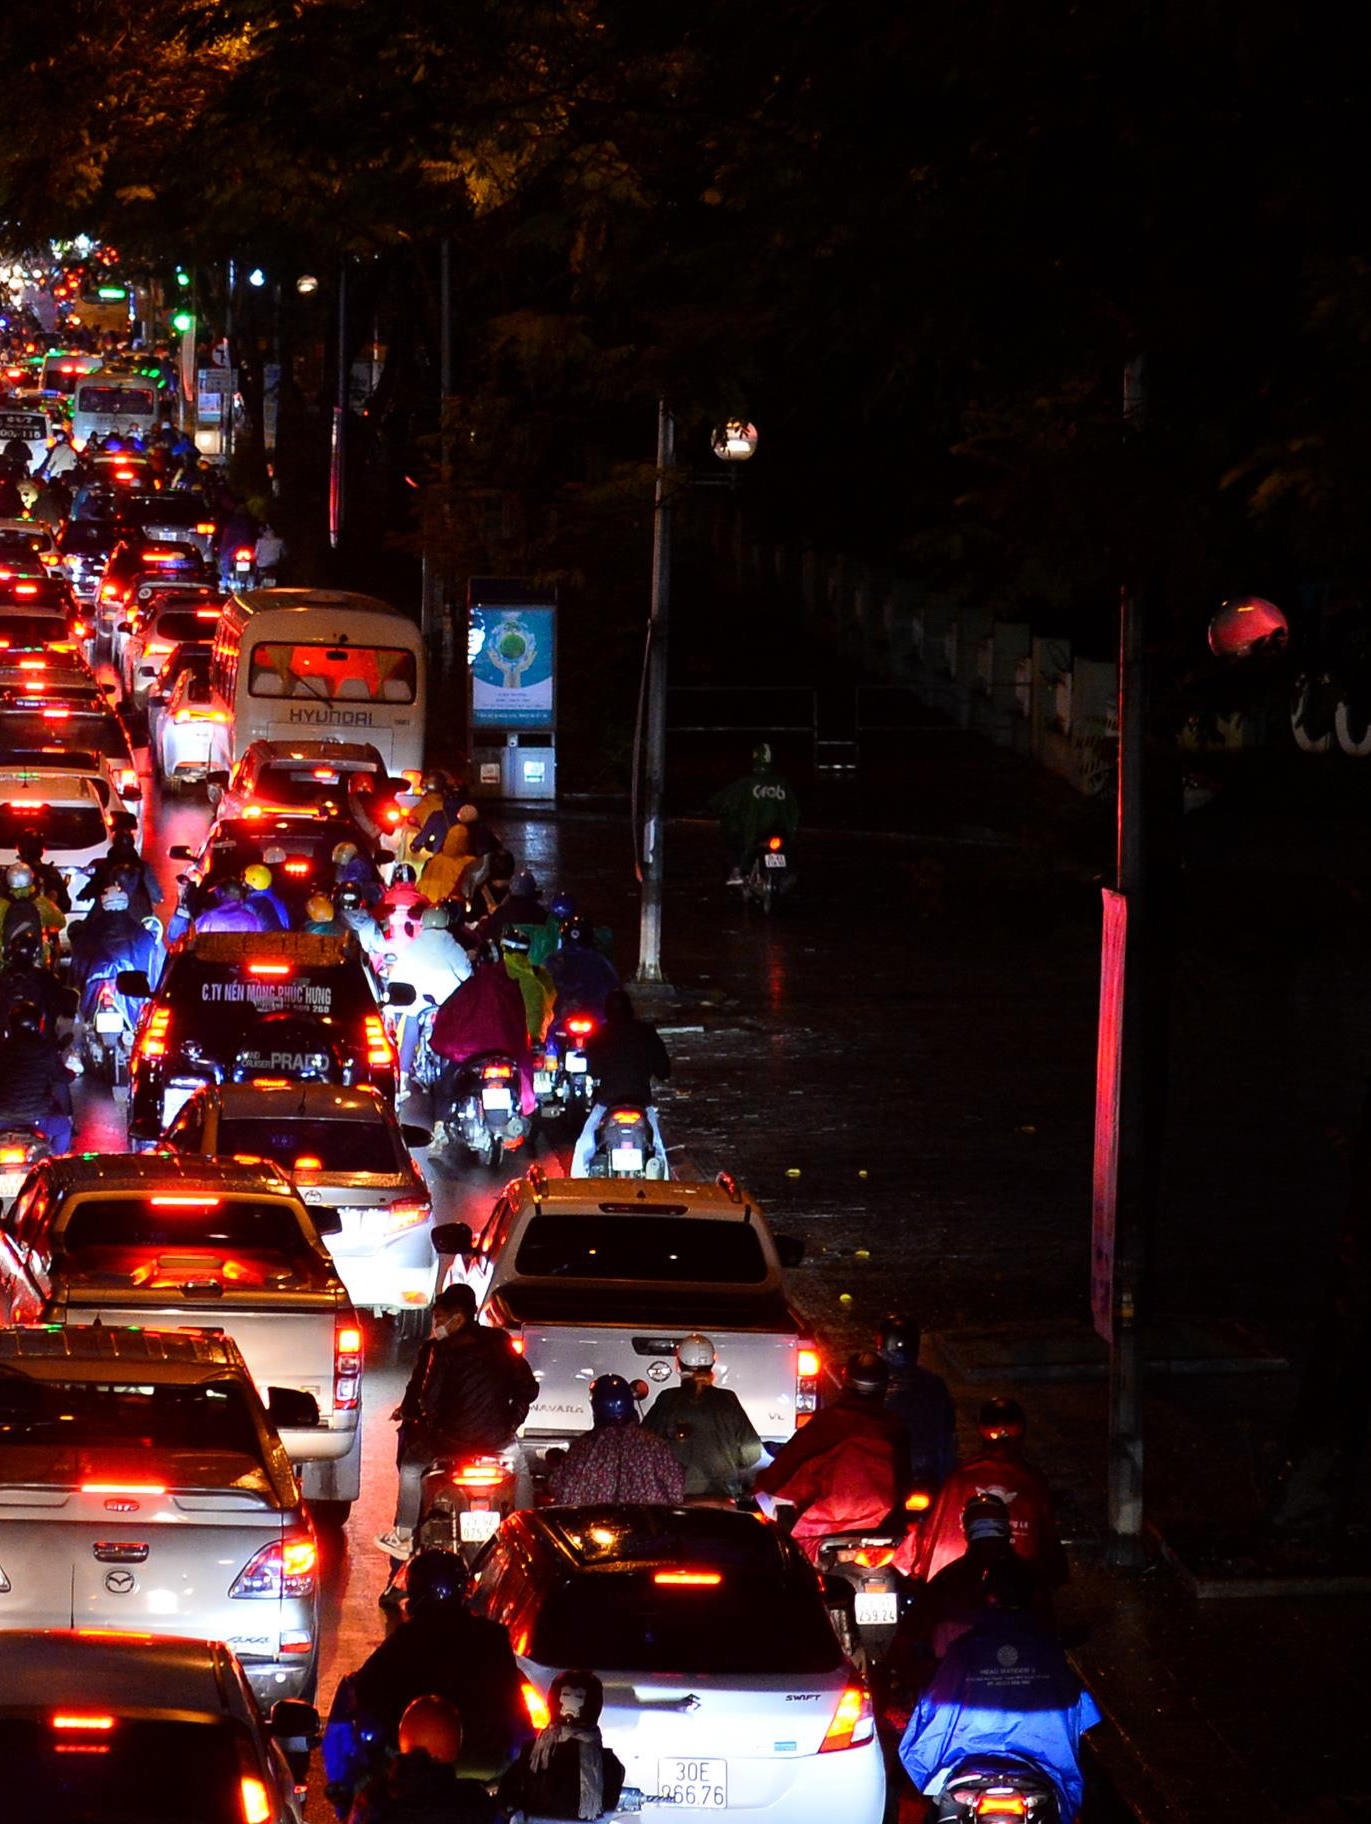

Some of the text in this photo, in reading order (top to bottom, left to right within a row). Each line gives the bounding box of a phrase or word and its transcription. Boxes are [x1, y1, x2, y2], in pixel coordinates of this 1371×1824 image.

[290, 708, 373, 726] HYUNDAI
[752, 784, 786, 800] Grab
[270, 1053, 330, 1072] PRADO
[530, 1404, 584, 1413] NAVARA
[785, 1694, 822, 1702] SWIFT
[675, 1762, 711, 1782] 30E
